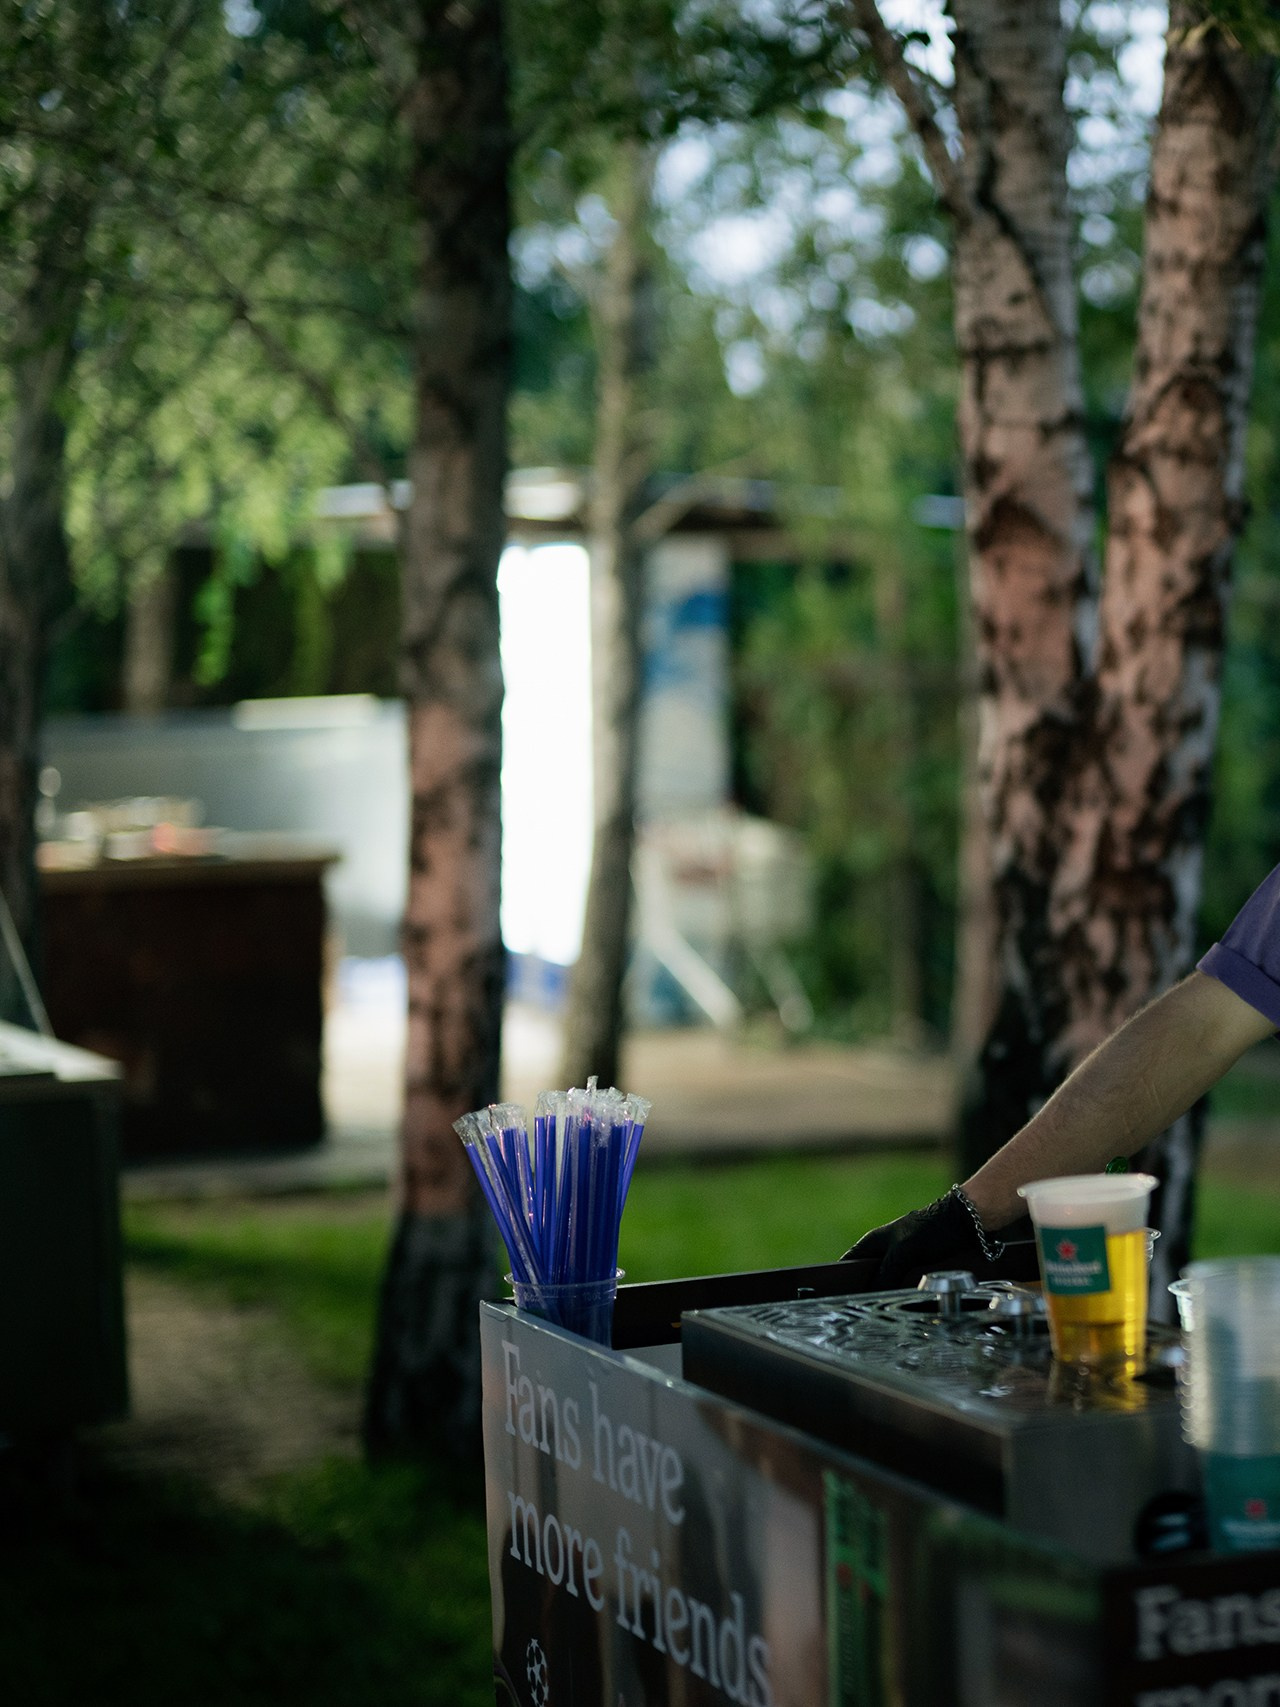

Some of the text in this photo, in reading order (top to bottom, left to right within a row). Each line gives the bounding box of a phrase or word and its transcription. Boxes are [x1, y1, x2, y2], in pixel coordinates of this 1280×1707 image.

[501, 1340, 687, 1526] Fans have
[508, 1491, 606, 1614] more
[615, 1525, 776, 1707] friends
